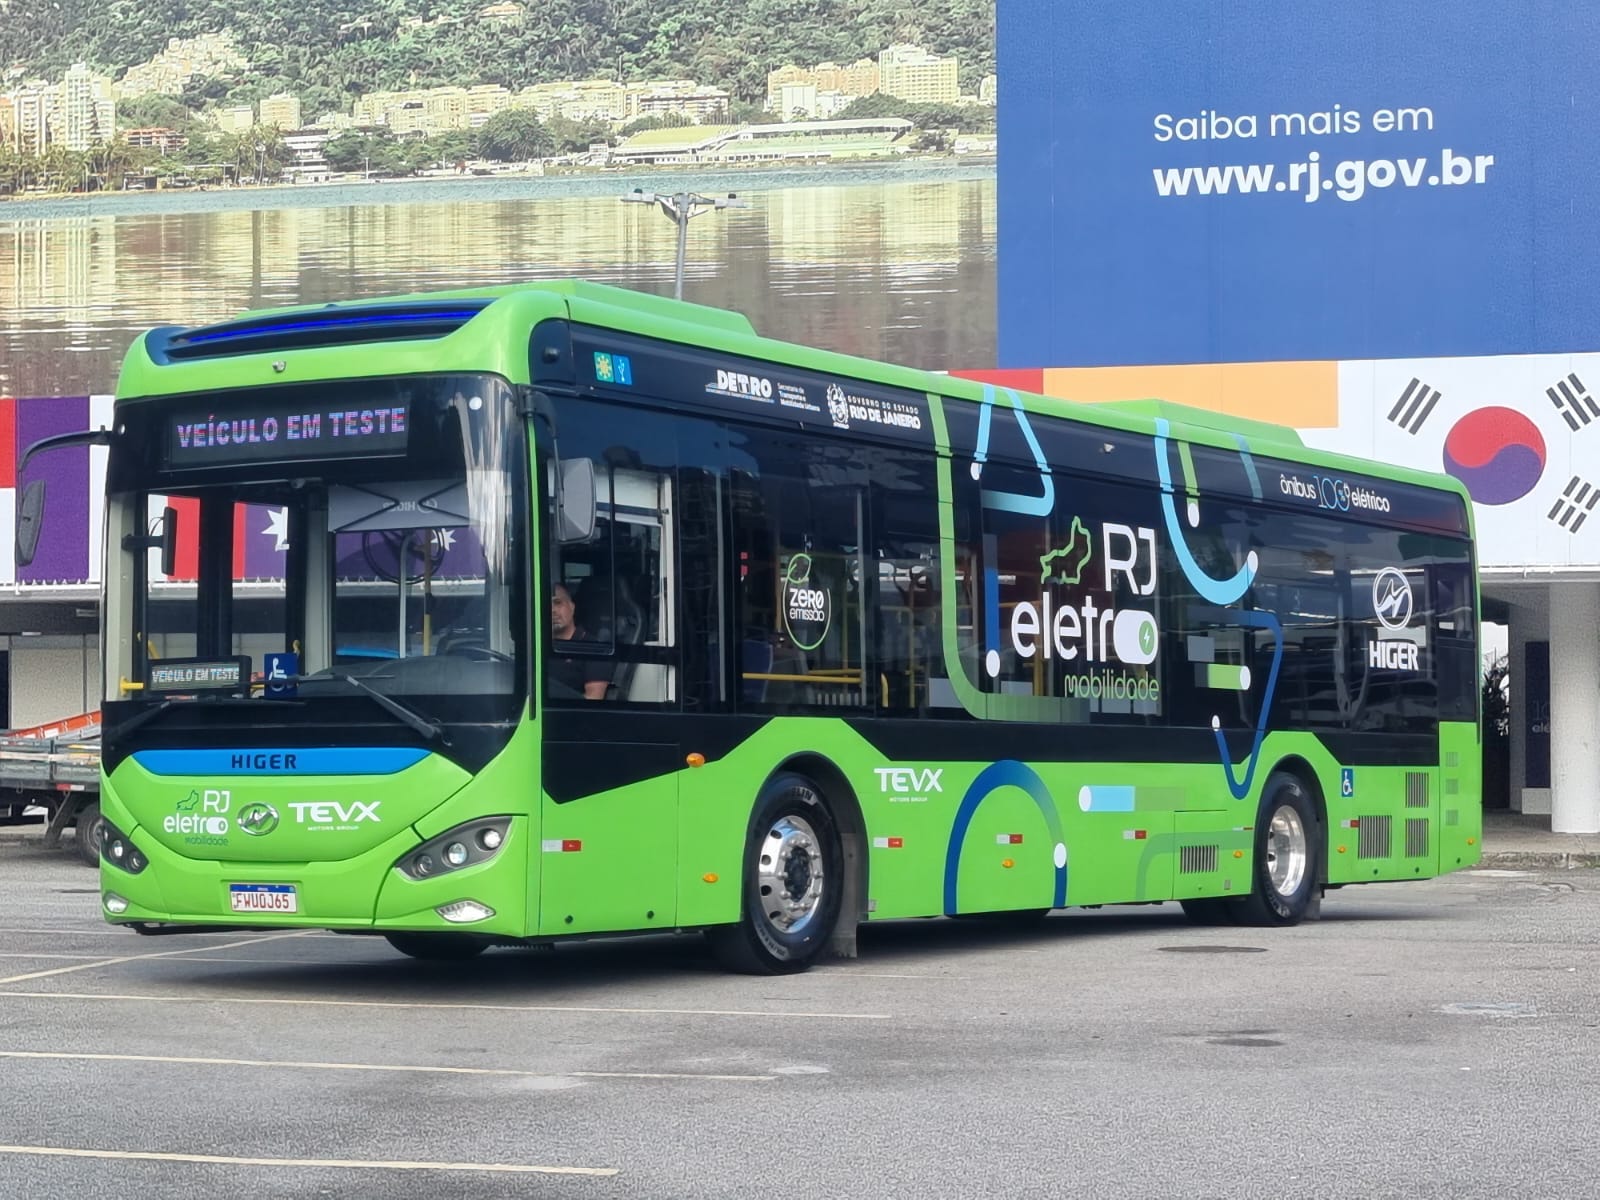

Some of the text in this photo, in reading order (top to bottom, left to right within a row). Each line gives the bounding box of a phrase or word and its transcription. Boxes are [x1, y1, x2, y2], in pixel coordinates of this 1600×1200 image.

[1153, 104, 1434, 142] Saiba mais em
[1152, 148, 1495, 203] www.rj.gov.br
[716, 369, 773, 398] DETRO
[177, 407, 406, 448] VEÍCULO EM TESTE
[849, 405, 921, 430] RIO DE JANEIRO
[1280, 473, 1317, 499] ônibus
[1351, 488, 1391, 513] elétrico
[1102, 522, 1158, 596] RJ
[789, 607, 825, 621] emissão
[1369, 640, 1419, 671] HIGER
[194, 668, 210, 681] EM
[210, 667, 240, 681] TESTE
[1064, 667, 1160, 701] mobilidade
[231, 754, 297, 770] HIGER
[873, 767, 944, 793] TEVX
[203, 790, 231, 813] RJ
[287, 801, 382, 823] TEVX
[184, 836, 229, 847] mobilidade
